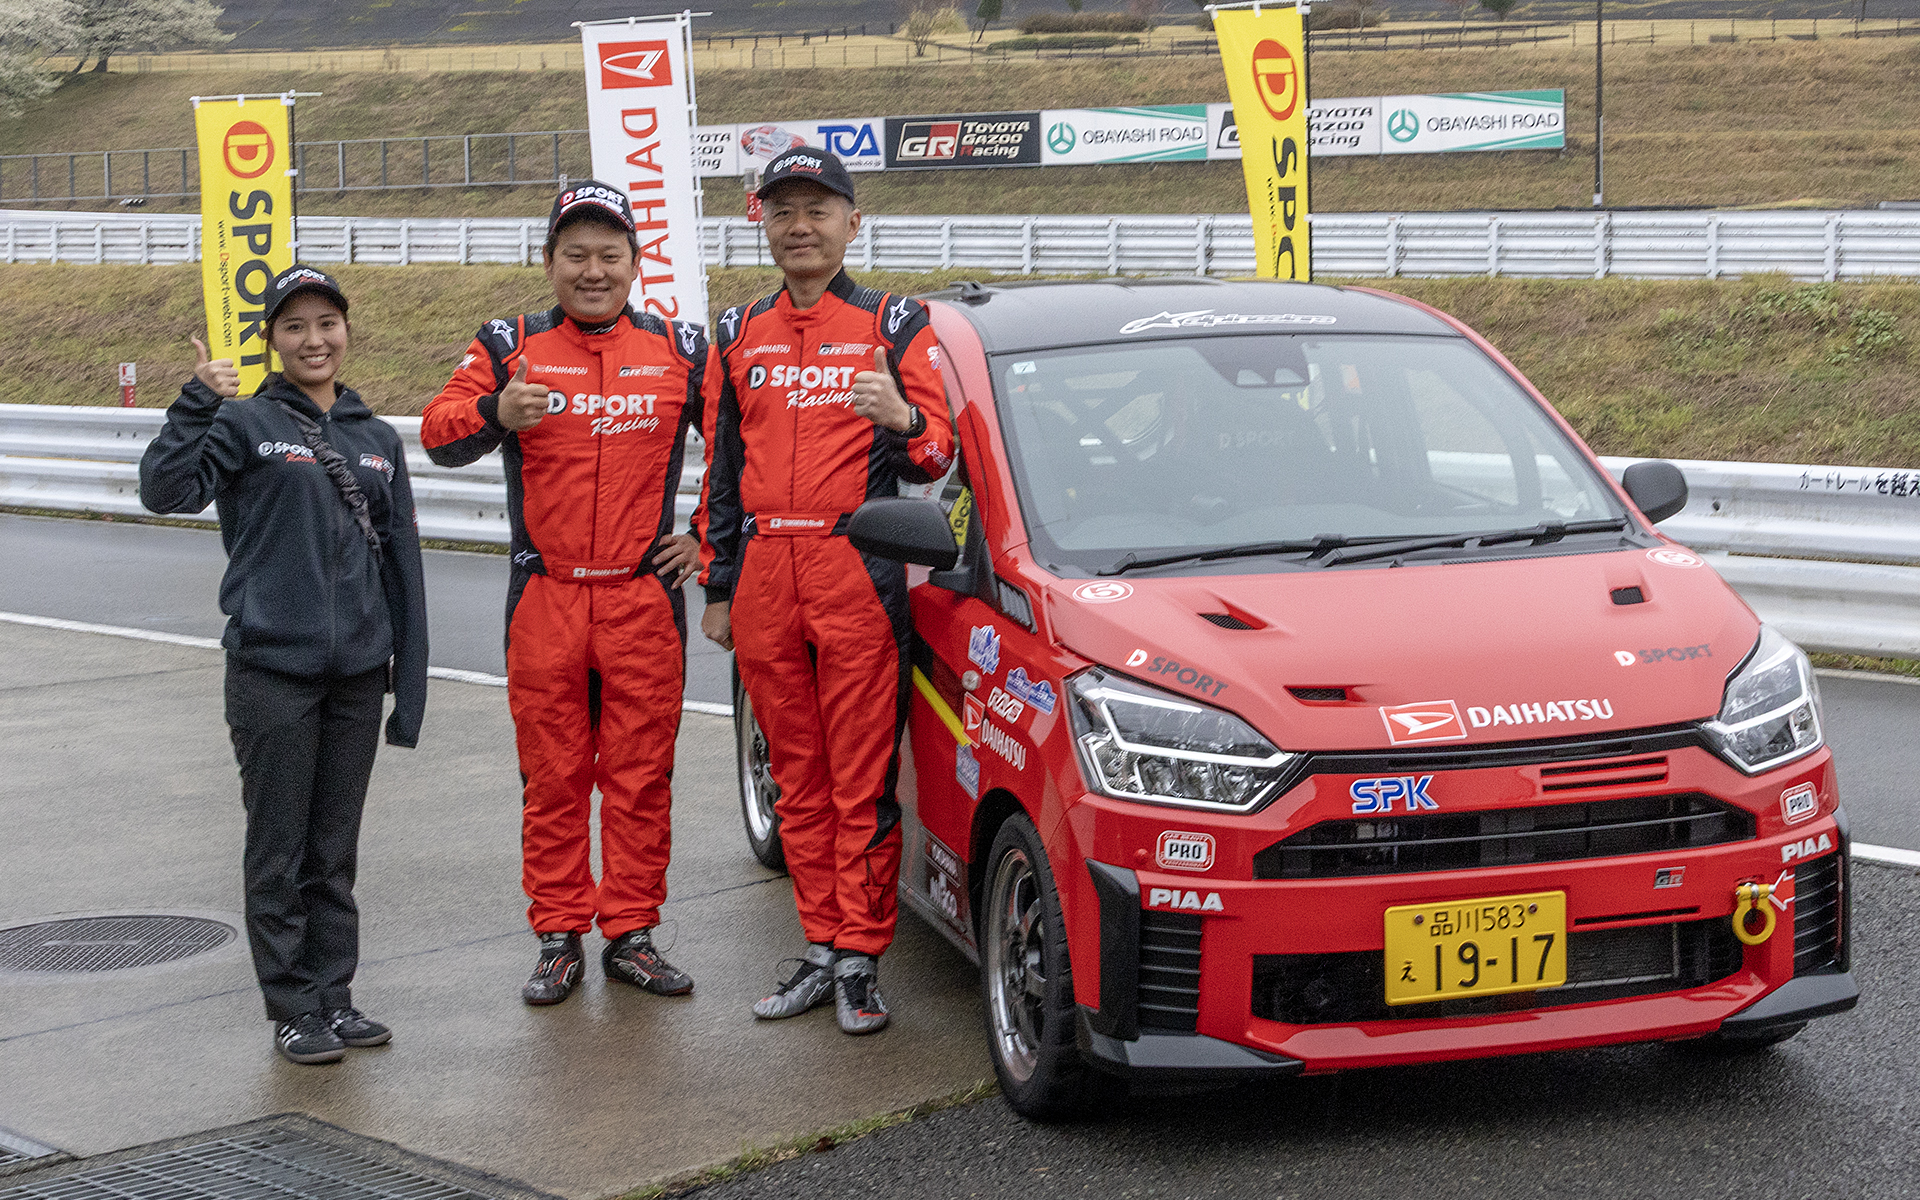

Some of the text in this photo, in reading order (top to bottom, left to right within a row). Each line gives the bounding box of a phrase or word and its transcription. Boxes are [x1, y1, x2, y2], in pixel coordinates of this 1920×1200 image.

[963, 121, 1030, 134] TOYOTA
[1426, 112, 1560, 131] OBAYASHI ROAD
[962, 133, 1023, 145] GAZOO
[1082, 127, 1155, 145] OBAYASHI
[1159, 125, 1203, 142] ROAD
[901, 136, 954, 156] GR
[960, 144, 1020, 159] Racing
[783, 155, 823, 170] SPORT
[575, 187, 624, 204] SPORT
[769, 365, 855, 389] SPORT
[571, 394, 657, 416] SPORT
[786, 389, 857, 409] Racing
[590, 416, 660, 436] Racing
[1614, 644, 1712, 667] D SPORT
[1125, 649, 1229, 697] D SPORT
[1466, 698, 1614, 728] DAIHATSU
[981, 718, 1027, 771] DAIHATSU
[1350, 774, 1440, 814] SPK
[1169, 842, 1202, 860] PRO
[1780, 833, 1833, 863] PIAA
[1149, 887, 1224, 911] PIAA
[1434, 932, 1556, 992] 19-17
